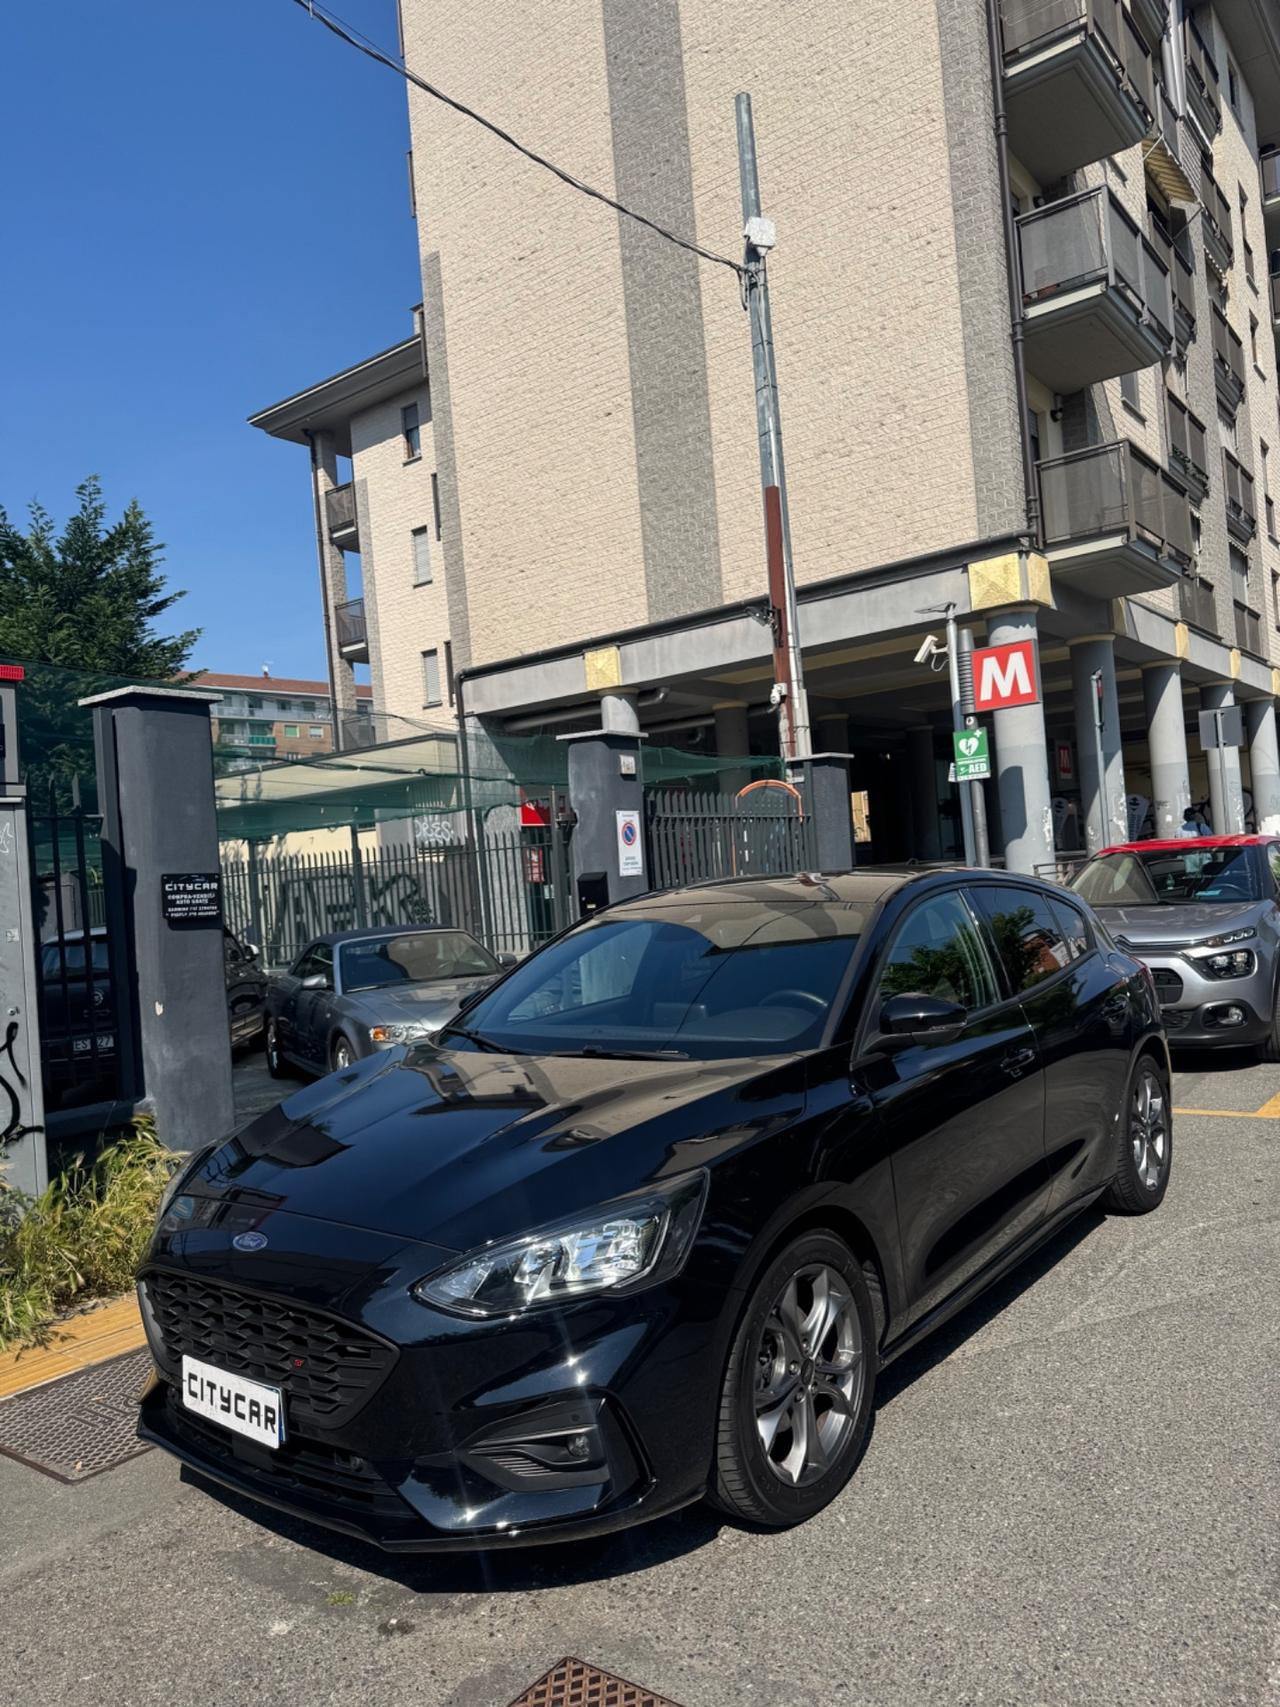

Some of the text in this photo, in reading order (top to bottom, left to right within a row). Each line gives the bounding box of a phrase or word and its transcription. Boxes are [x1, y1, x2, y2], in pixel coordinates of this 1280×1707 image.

[980, 651, 1032, 702] M
[968, 763, 987, 773] AED
[165, 882, 218, 891] CITYCAR
[188, 1372, 276, 1433] CITYCAR
